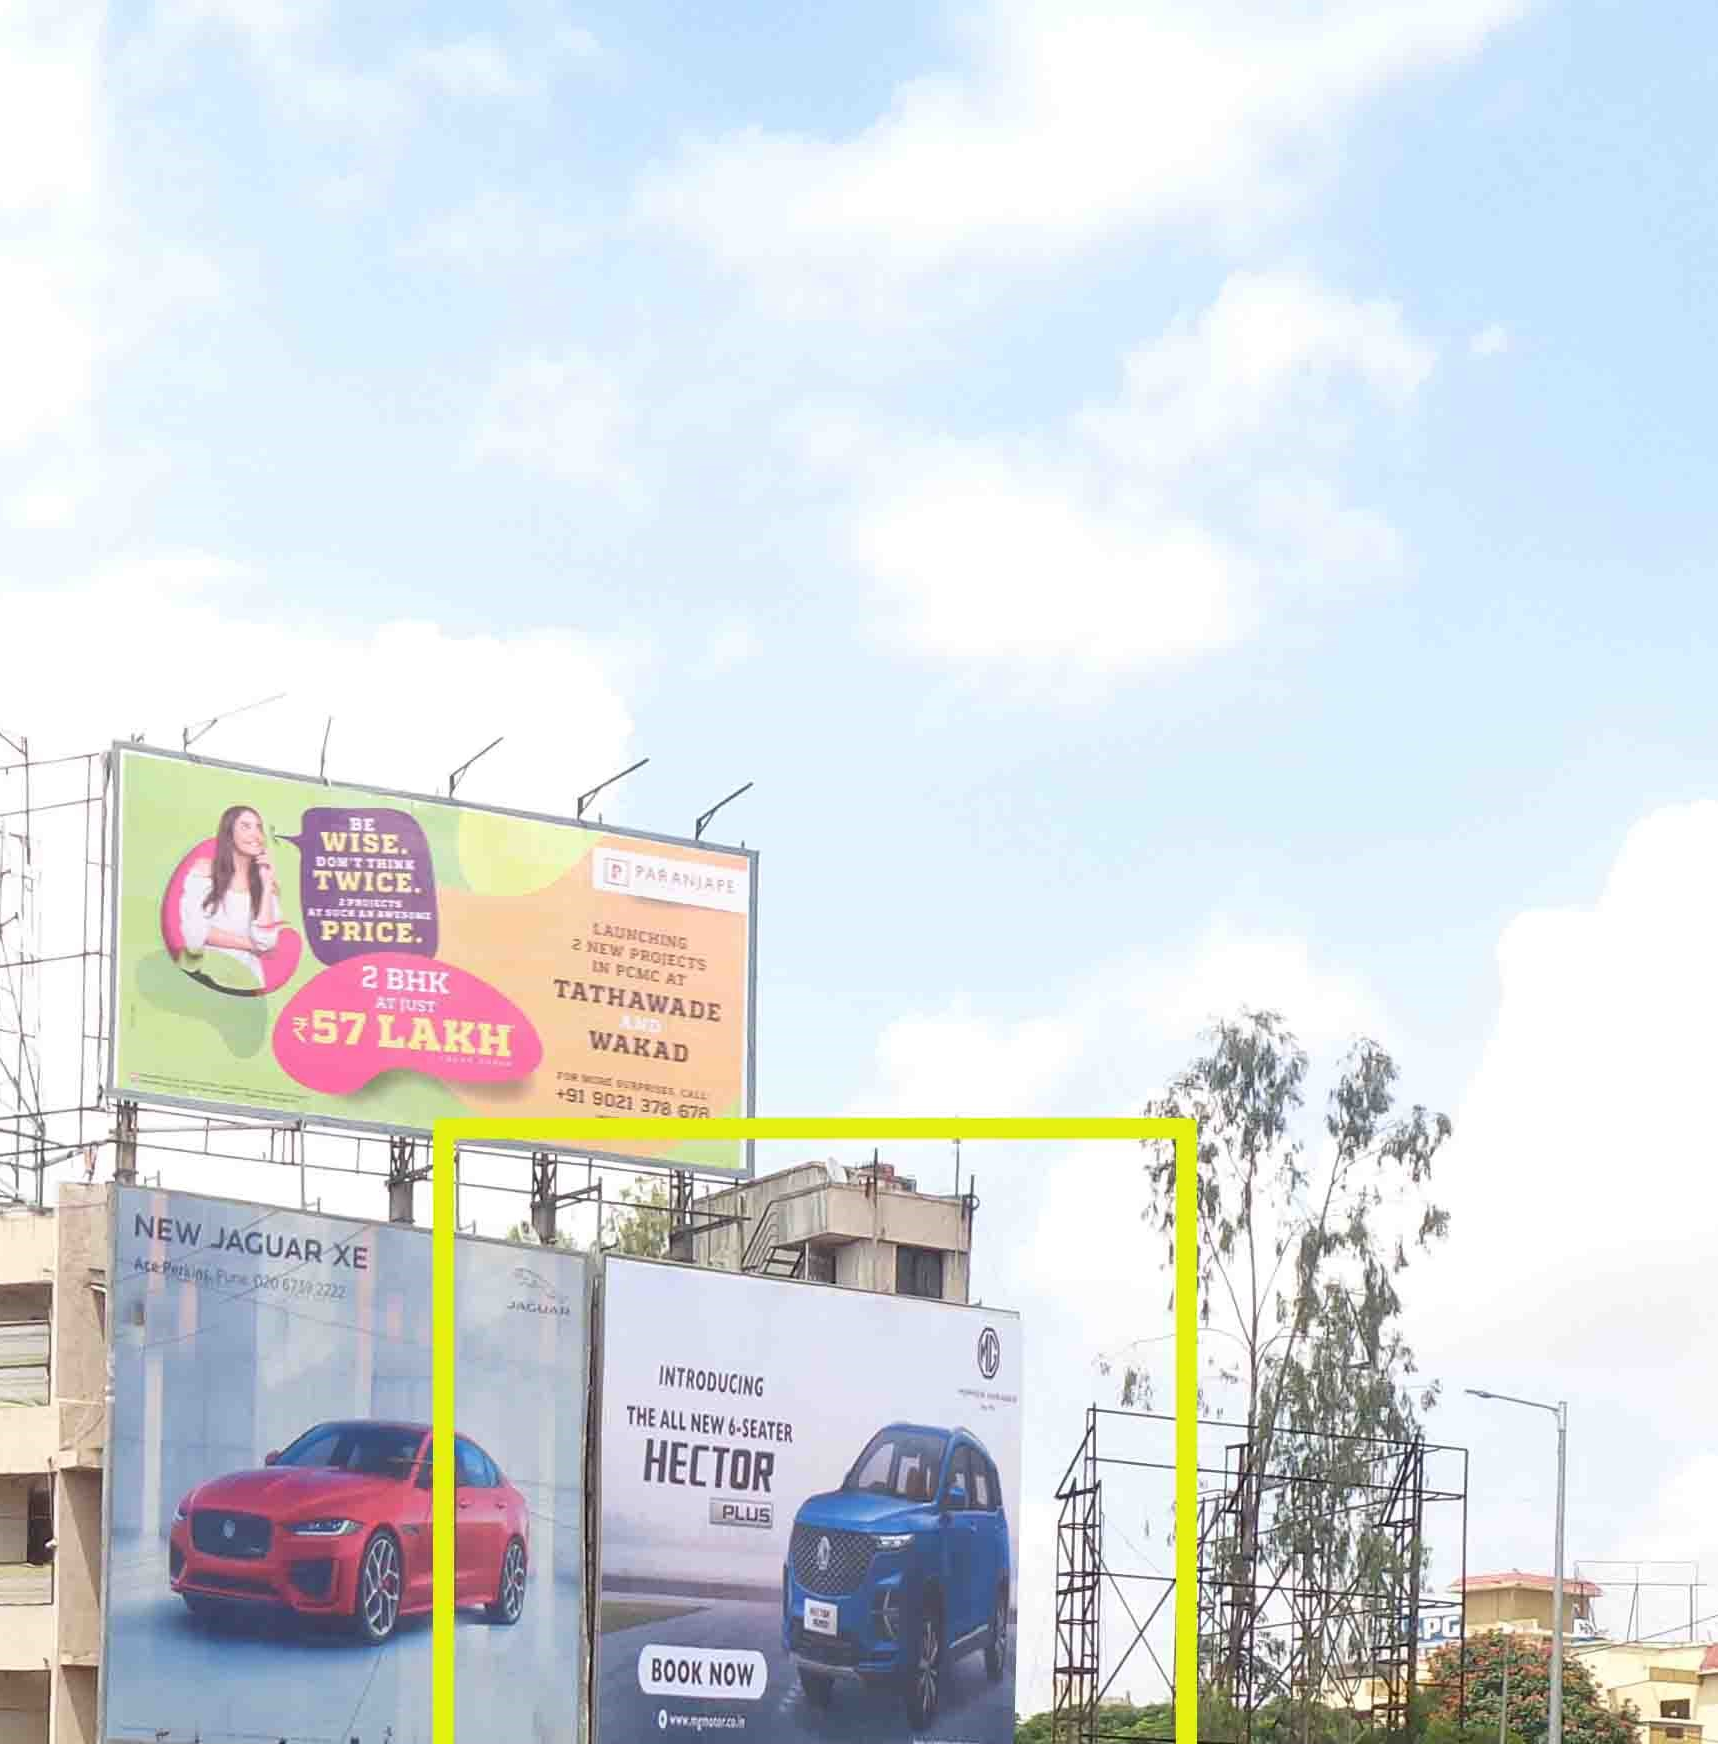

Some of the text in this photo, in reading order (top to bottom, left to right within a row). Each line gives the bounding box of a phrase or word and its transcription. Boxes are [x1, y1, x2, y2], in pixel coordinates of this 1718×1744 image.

[349, 817, 376, 832] BE
[319, 831, 409, 855] WISE.
[315, 856, 415, 870] DON'T THINK
[313, 869, 422, 894] TWICE.
[634, 864, 737, 894] PARANJAPE
[319, 920, 423, 944] PRICE.
[592, 922, 689, 950] LAUNCHING
[571, 938, 708, 972] 2 NEW PROJECTS
[362, 965, 450, 994] 2 BHK
[592, 959, 688, 986] IN PCMC AT
[375, 996, 436, 1014] AT JUST
[553, 978, 722, 1023] TATHAWADE
[377, 1014, 515, 1057] LAKH
[589, 1030, 690, 1063] WAKAD
[556, 1088, 585, 1104] +91
[592, 1091, 633, 1111] 9021
[642, 1098, 672, 1116] 378
[134, 1213, 370, 1270] NEW JAGUAR XE
[659, 1364, 764, 1398] INTRODUCING
[627, 1404, 794, 1444] THE ALL NEW 6-SEATER
[643, 1437, 775, 1493] HECTOR
[722, 1503, 771, 1524] PLUS
[651, 1657, 755, 1688] BOOK NOW
